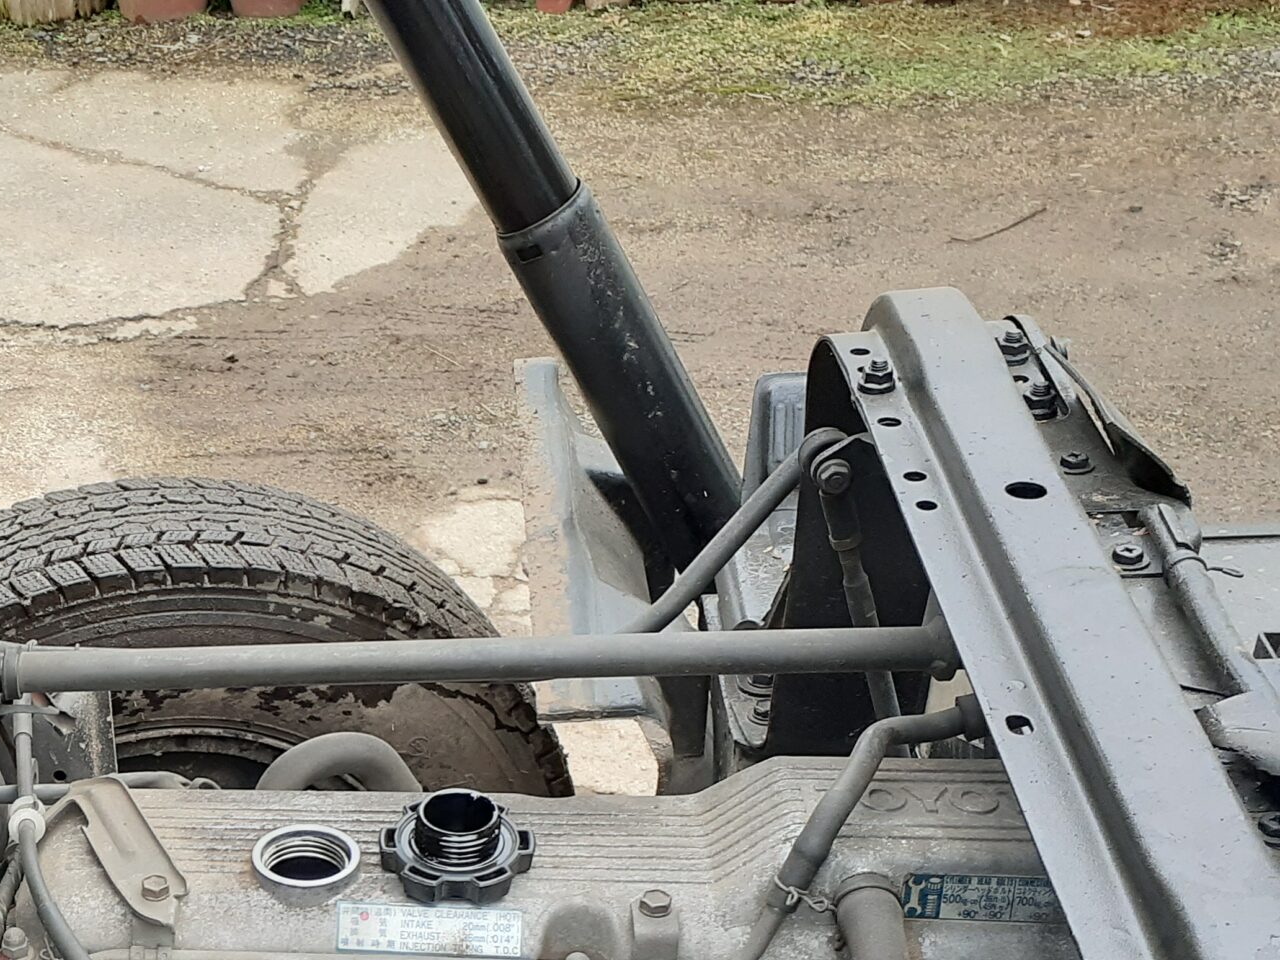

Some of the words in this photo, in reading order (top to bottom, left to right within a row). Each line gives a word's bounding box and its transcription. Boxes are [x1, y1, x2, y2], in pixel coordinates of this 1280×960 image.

[400, 908, 430, 919] VALVE
[434, 910, 488, 921] CLEARANCE
[400, 919, 433, 930] INTAKE
[400, 931, 441, 941] EXHAUST
[399, 941, 447, 952] INJECTION
